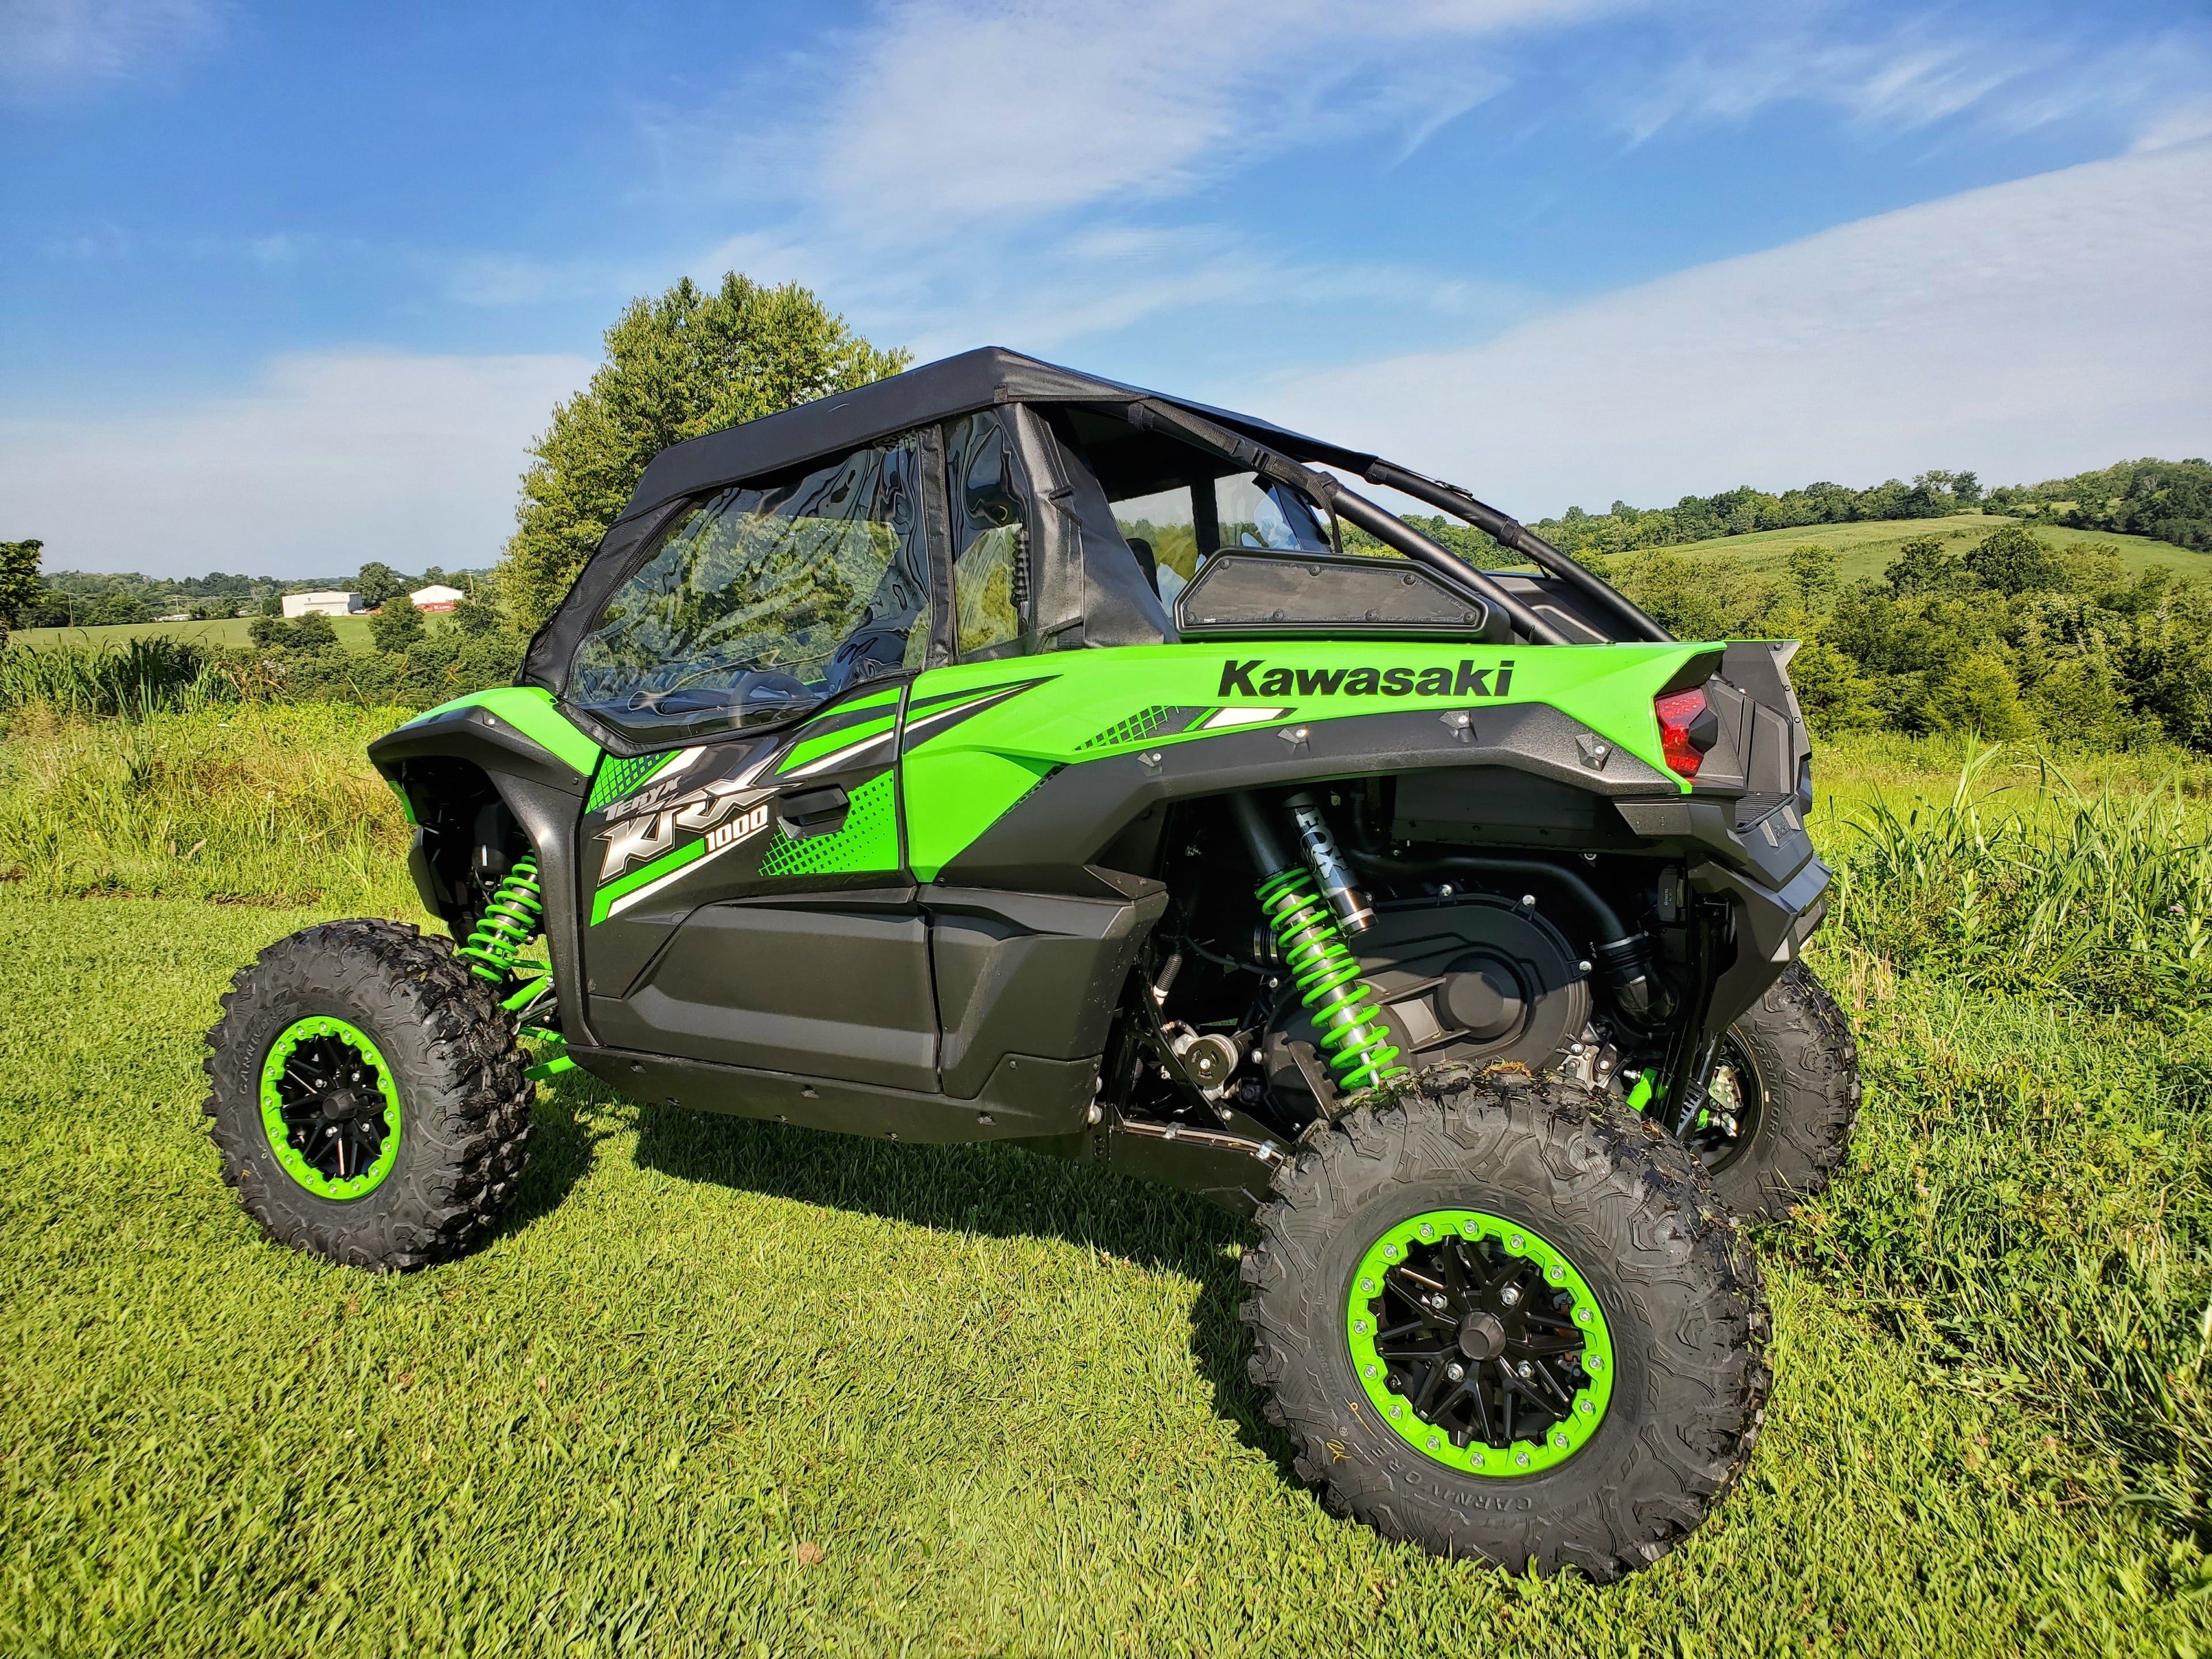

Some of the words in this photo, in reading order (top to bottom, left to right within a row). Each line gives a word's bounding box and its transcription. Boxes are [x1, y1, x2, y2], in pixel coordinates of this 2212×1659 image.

[1217, 660, 1516, 697] Kawasaki
[596, 745, 792, 886] KRX
[603, 775, 684, 821] TERYX
[705, 805, 768, 853] 1000
[1296, 807, 1349, 879] FOX
[1371, 1444, 1533, 1512] CARNIVORE
